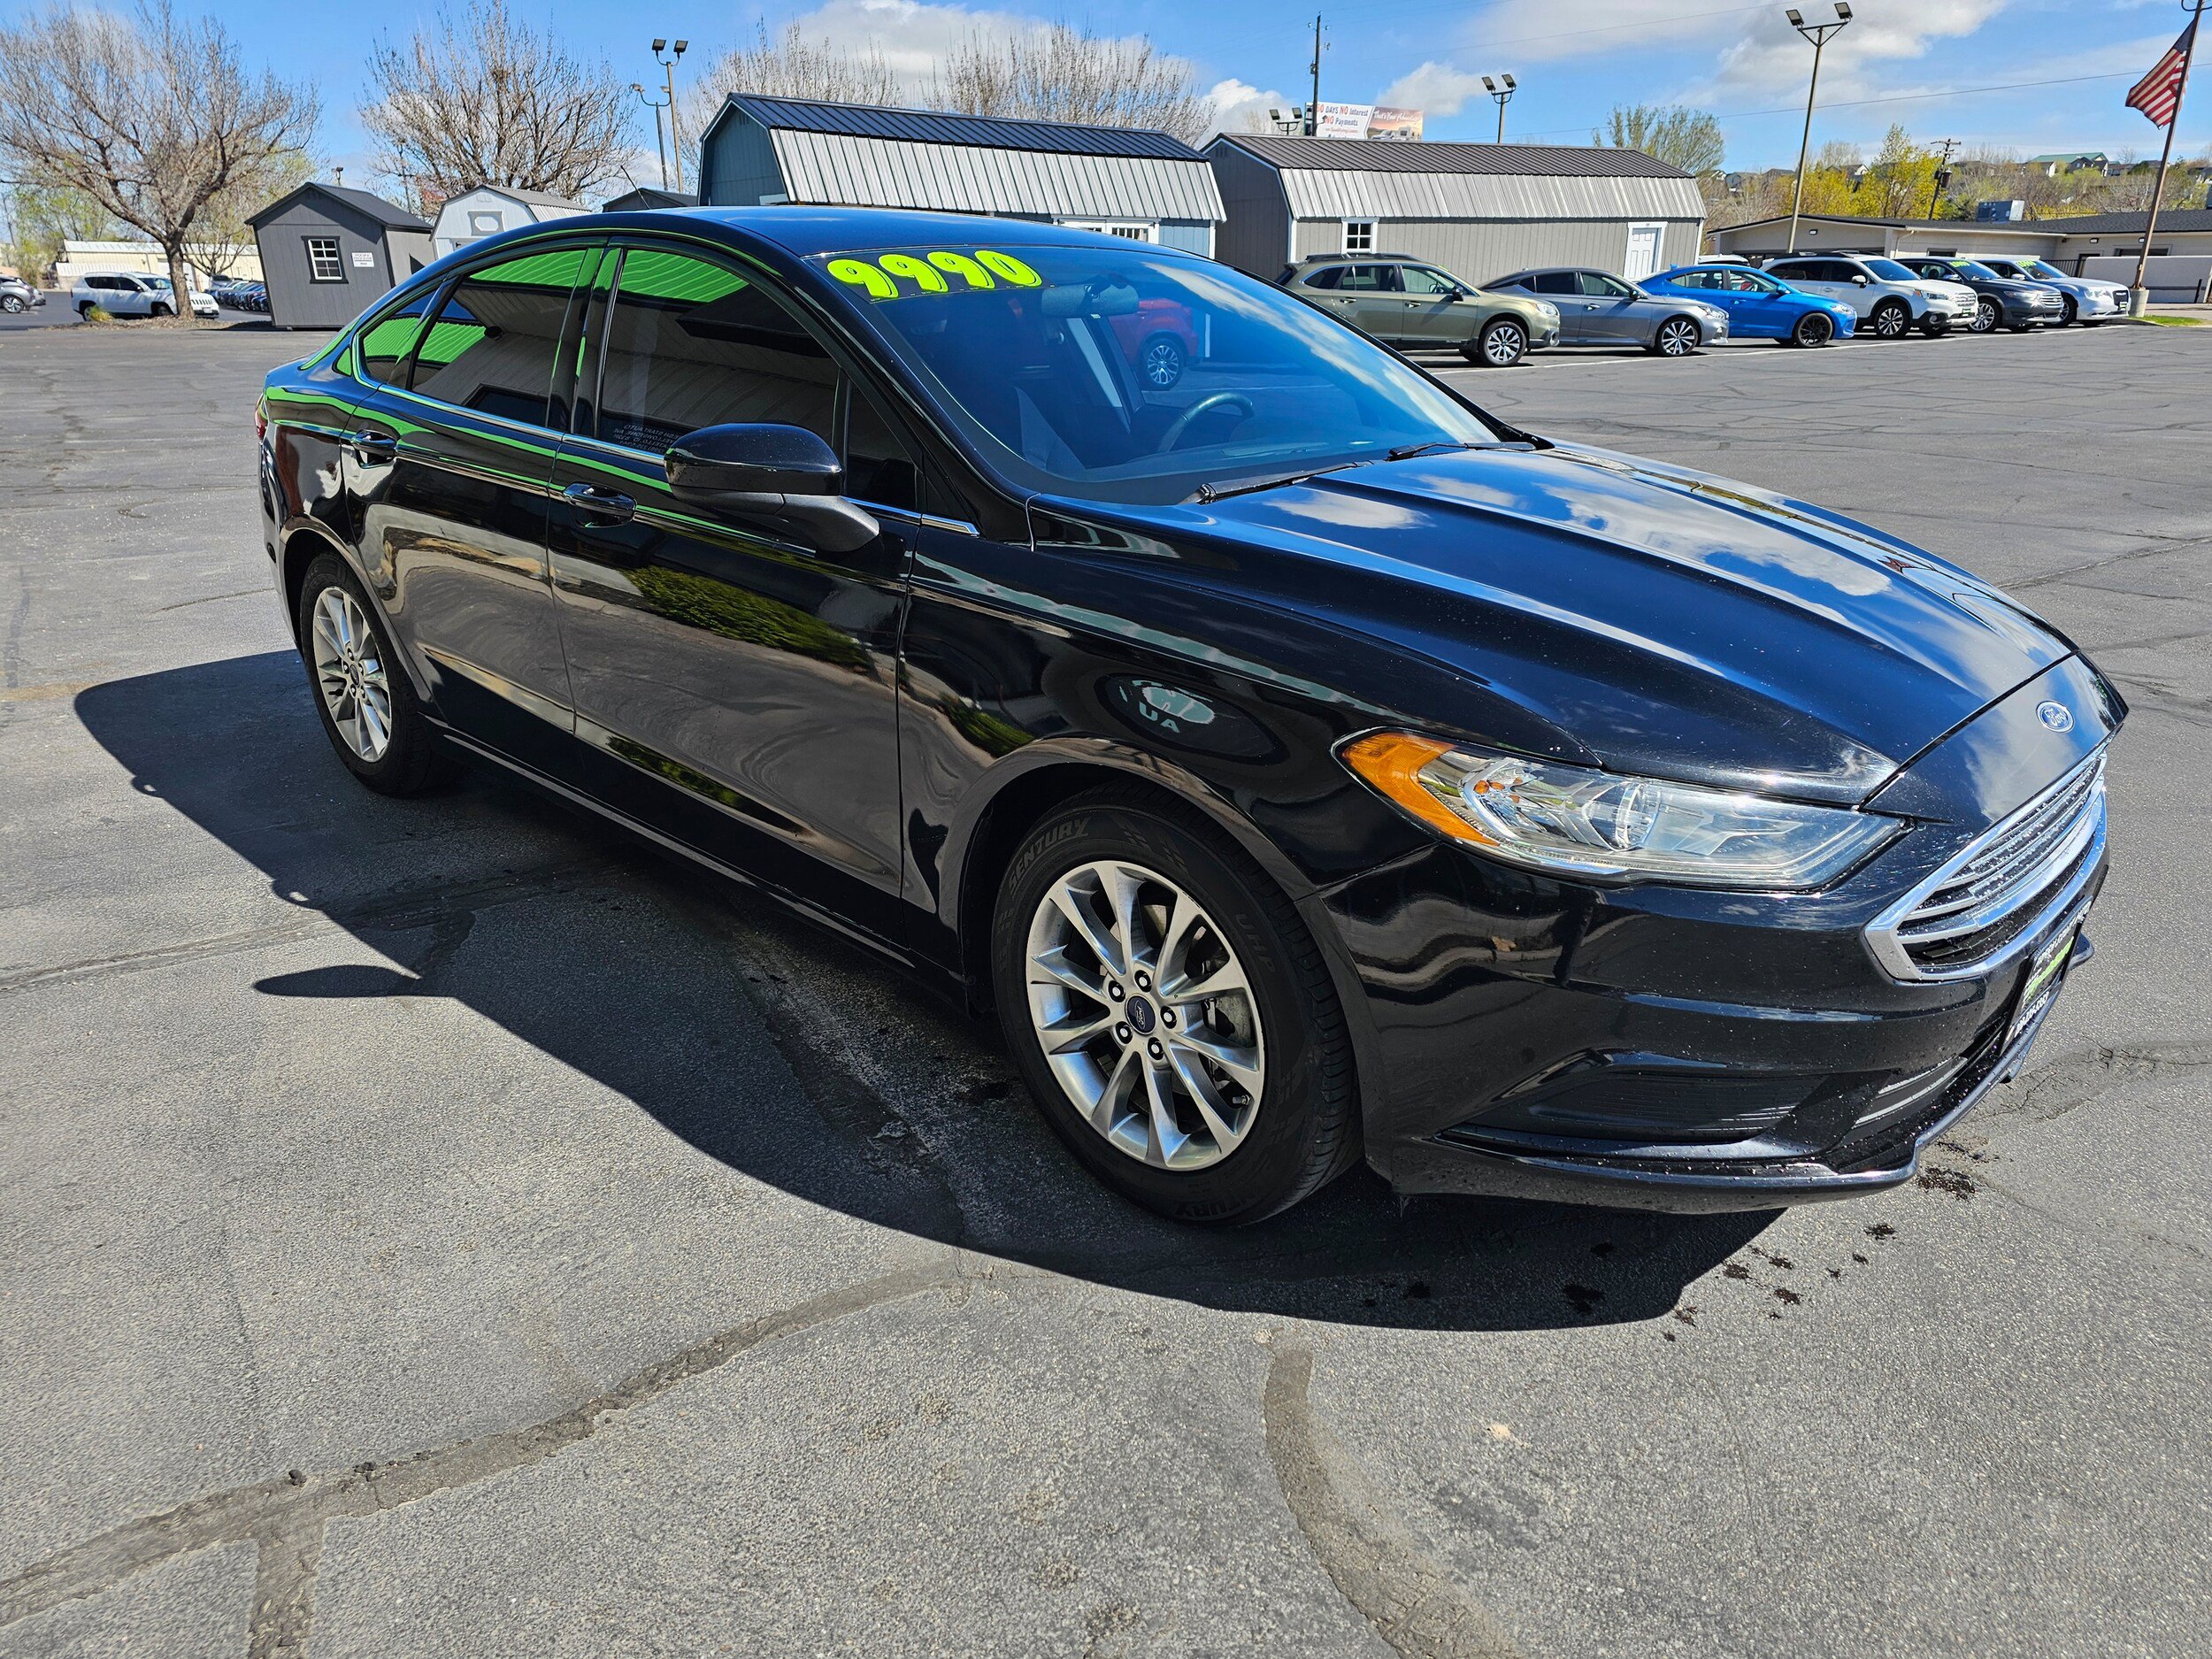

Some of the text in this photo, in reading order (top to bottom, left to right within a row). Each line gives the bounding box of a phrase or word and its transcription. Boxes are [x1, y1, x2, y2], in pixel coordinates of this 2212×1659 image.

[1340, 105, 1348, 115] NO
[1349, 107, 1369, 116] Interest
[1325, 115, 1358, 127] NO Payments
[827, 250, 1042, 298] 9990
[2044, 707, 2068, 727] Ford
[1008, 816, 1093, 897] SENTURY
